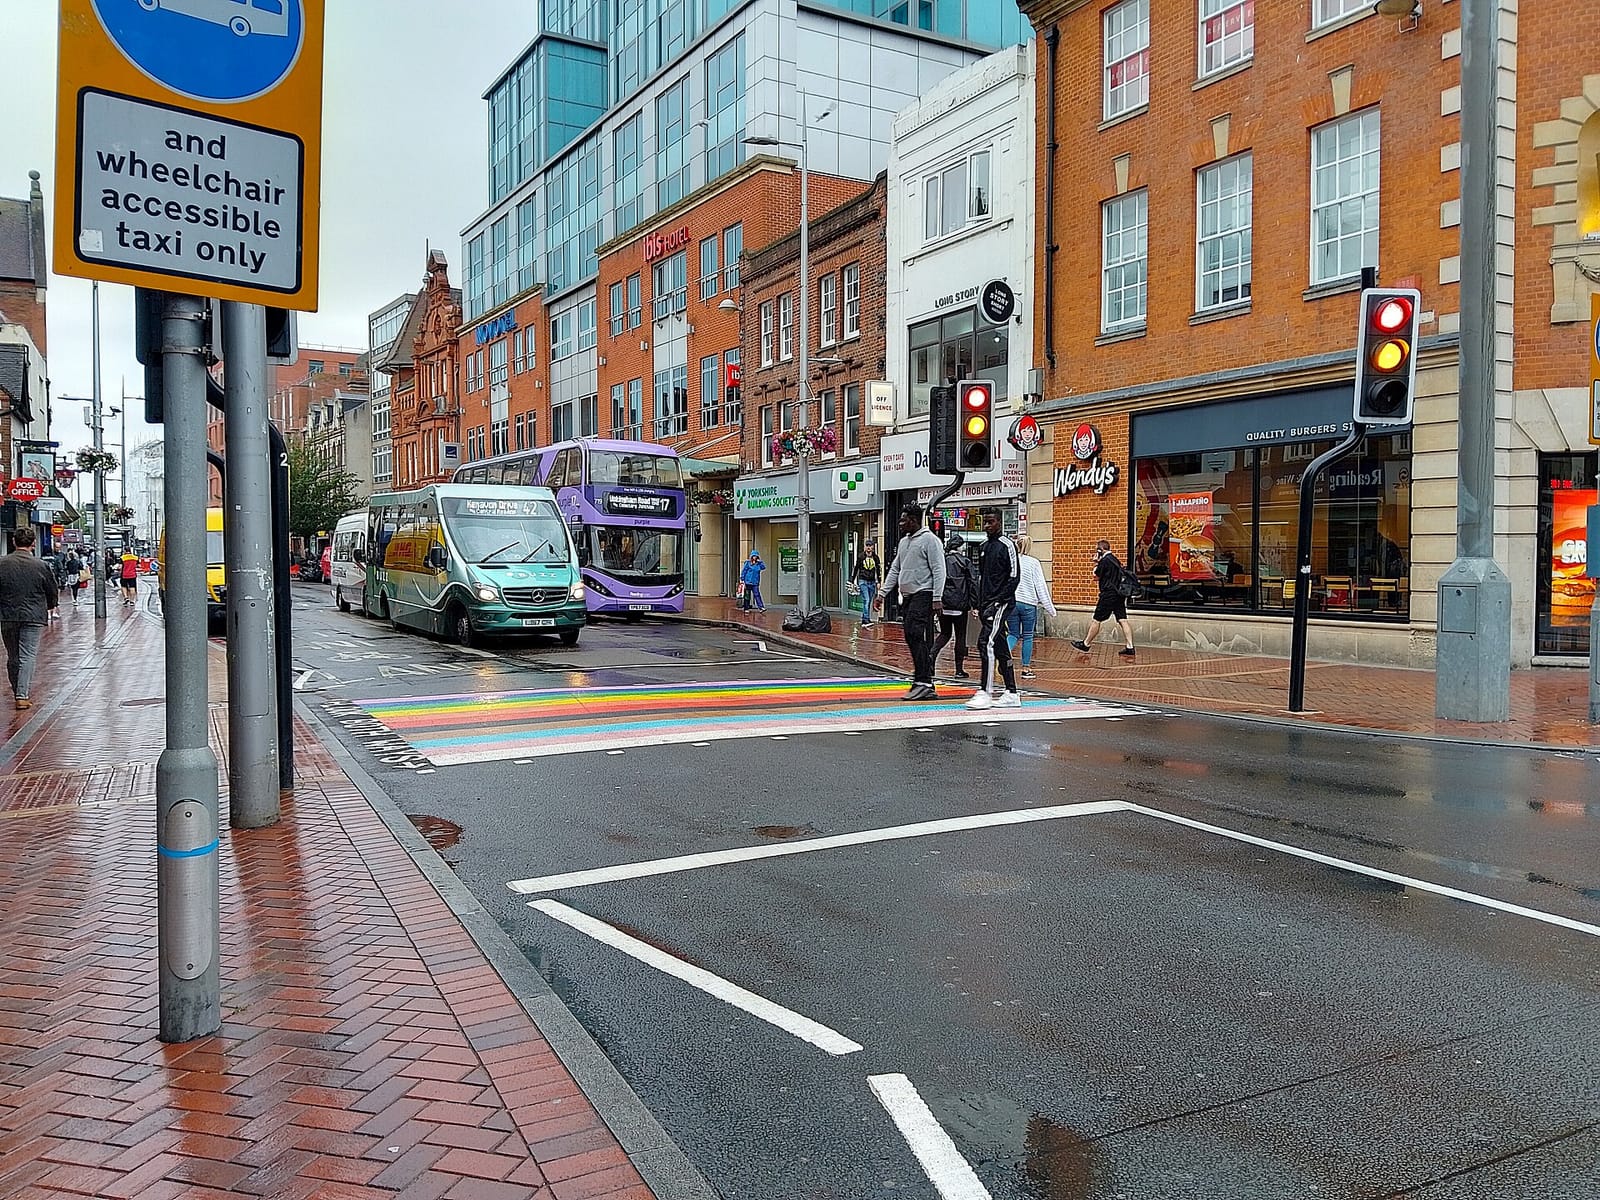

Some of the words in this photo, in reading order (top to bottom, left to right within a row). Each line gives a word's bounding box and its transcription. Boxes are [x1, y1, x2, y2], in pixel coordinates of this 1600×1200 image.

[164, 130, 226, 160] and
[96, 150, 286, 206] wheelchair
[101, 187, 281, 240] accessible
[116, 220, 182, 256] taxi
[196, 240, 267, 274] only
[644, 231, 663, 262] ibis
[664, 225, 689, 251] HOTEL
[934, 294, 954, 308] LONG
[955, 286, 980, 302] STORY
[989, 292, 1009, 306] STORY
[1246, 429, 1285, 441] QUALITY
[1290, 424, 1336, 436] BURGERS
[280, 452, 288, 466] 2
[1054, 457, 1115, 497] Wendy's
[748, 486, 777, 498] YORKSHIRE
[920, 491, 932, 499] OFF
[966, 486, 992, 496] MOBILE
[523, 501, 537, 515] 42
[660, 498, 670, 511] 17
[748, 498, 771, 509] BUILDING
[772, 496, 795, 507] SOCIETY
[1176, 497, 1208, 505] JALAPEÑO
